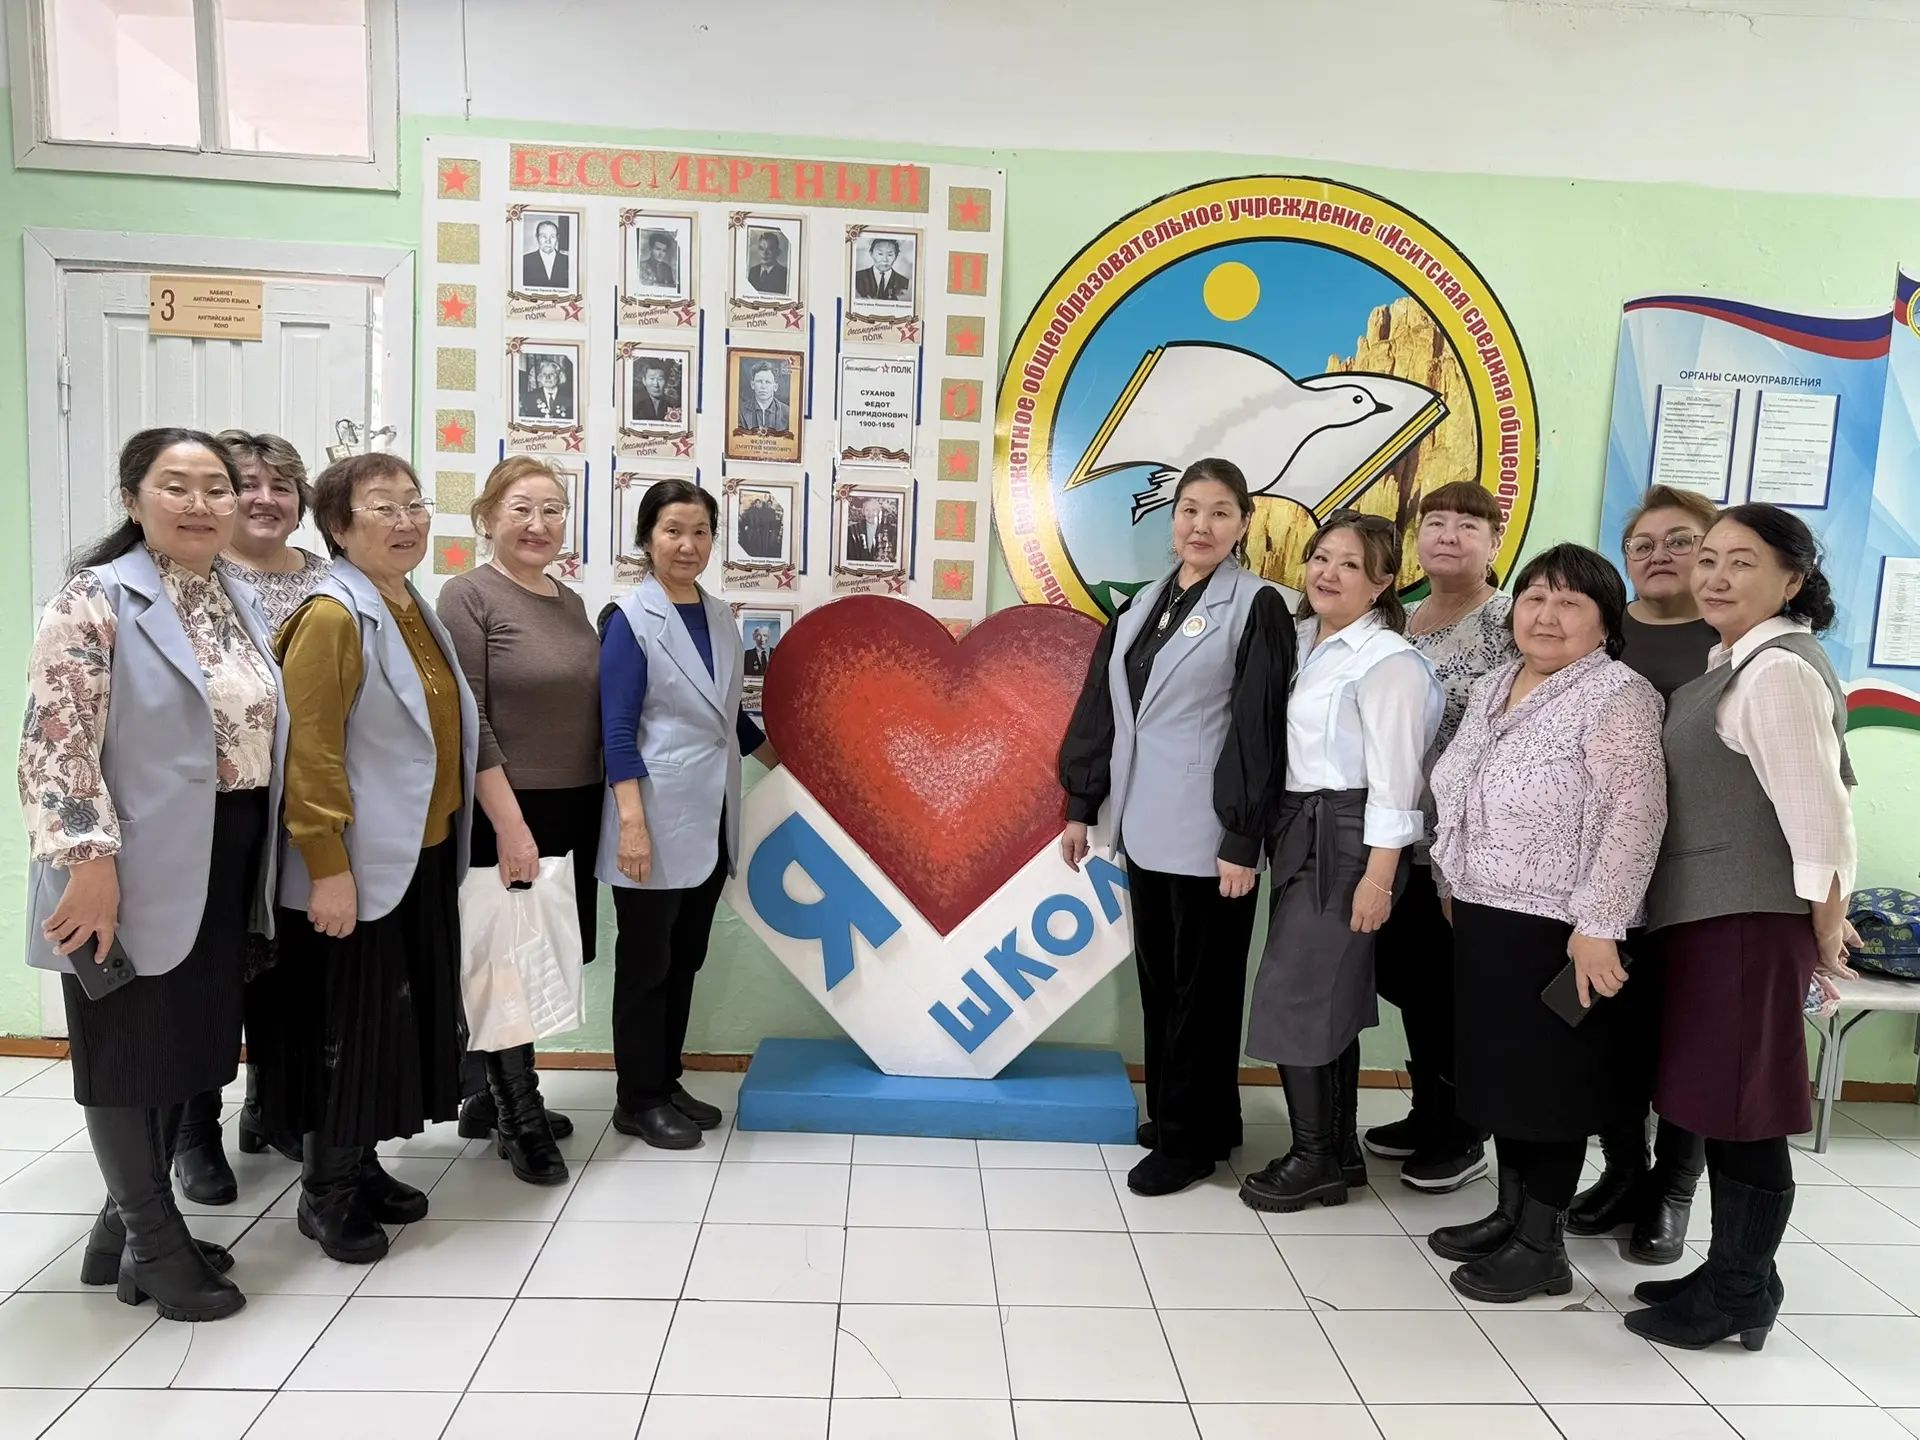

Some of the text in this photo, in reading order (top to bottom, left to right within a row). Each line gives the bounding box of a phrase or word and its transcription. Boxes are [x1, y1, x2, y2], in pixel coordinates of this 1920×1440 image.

[161, 289, 175, 321] 3
[1021, 203, 1224, 395] общеобразовательное
[1228, 196, 1375, 235] учреждение
[1376, 224, 1472, 311] «Иситская
[1463, 307, 1514, 402] средняя
[891, 365, 912, 374] ПОЛК
[1679, 370, 1822, 387] ОРГАНЫ САМОУПРАВЛЕНИЯ
[846, 410, 908, 419] СПИРИДОНОВИЧ
[747, 811, 1131, 1054] Я ШКОЛ
